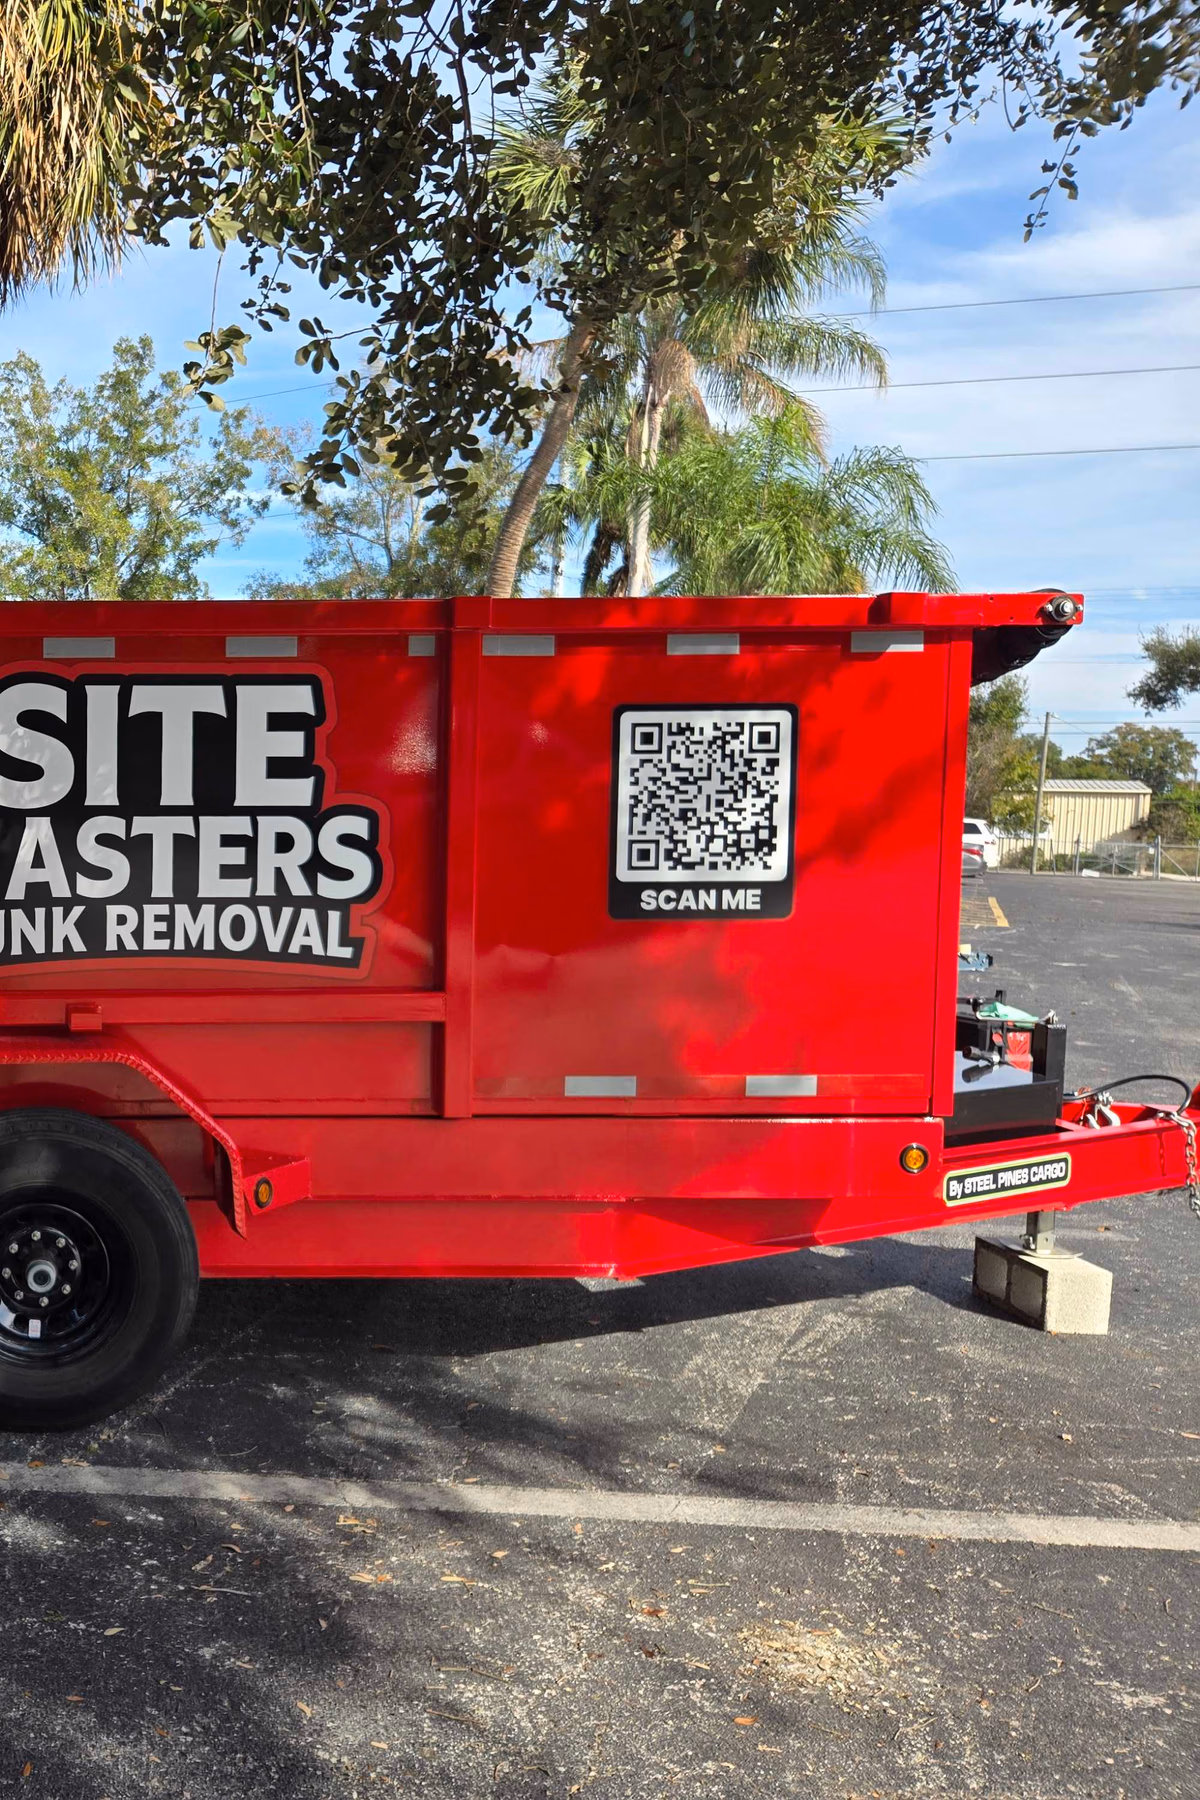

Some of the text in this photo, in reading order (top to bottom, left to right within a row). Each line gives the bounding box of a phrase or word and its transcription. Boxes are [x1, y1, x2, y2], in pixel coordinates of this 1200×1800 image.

[640, 889, 762, 911] SCAN ME
[105, 904, 355, 959] REMOVAL
[949, 1162, 1066, 1199] By STEEL PINES CARGO
